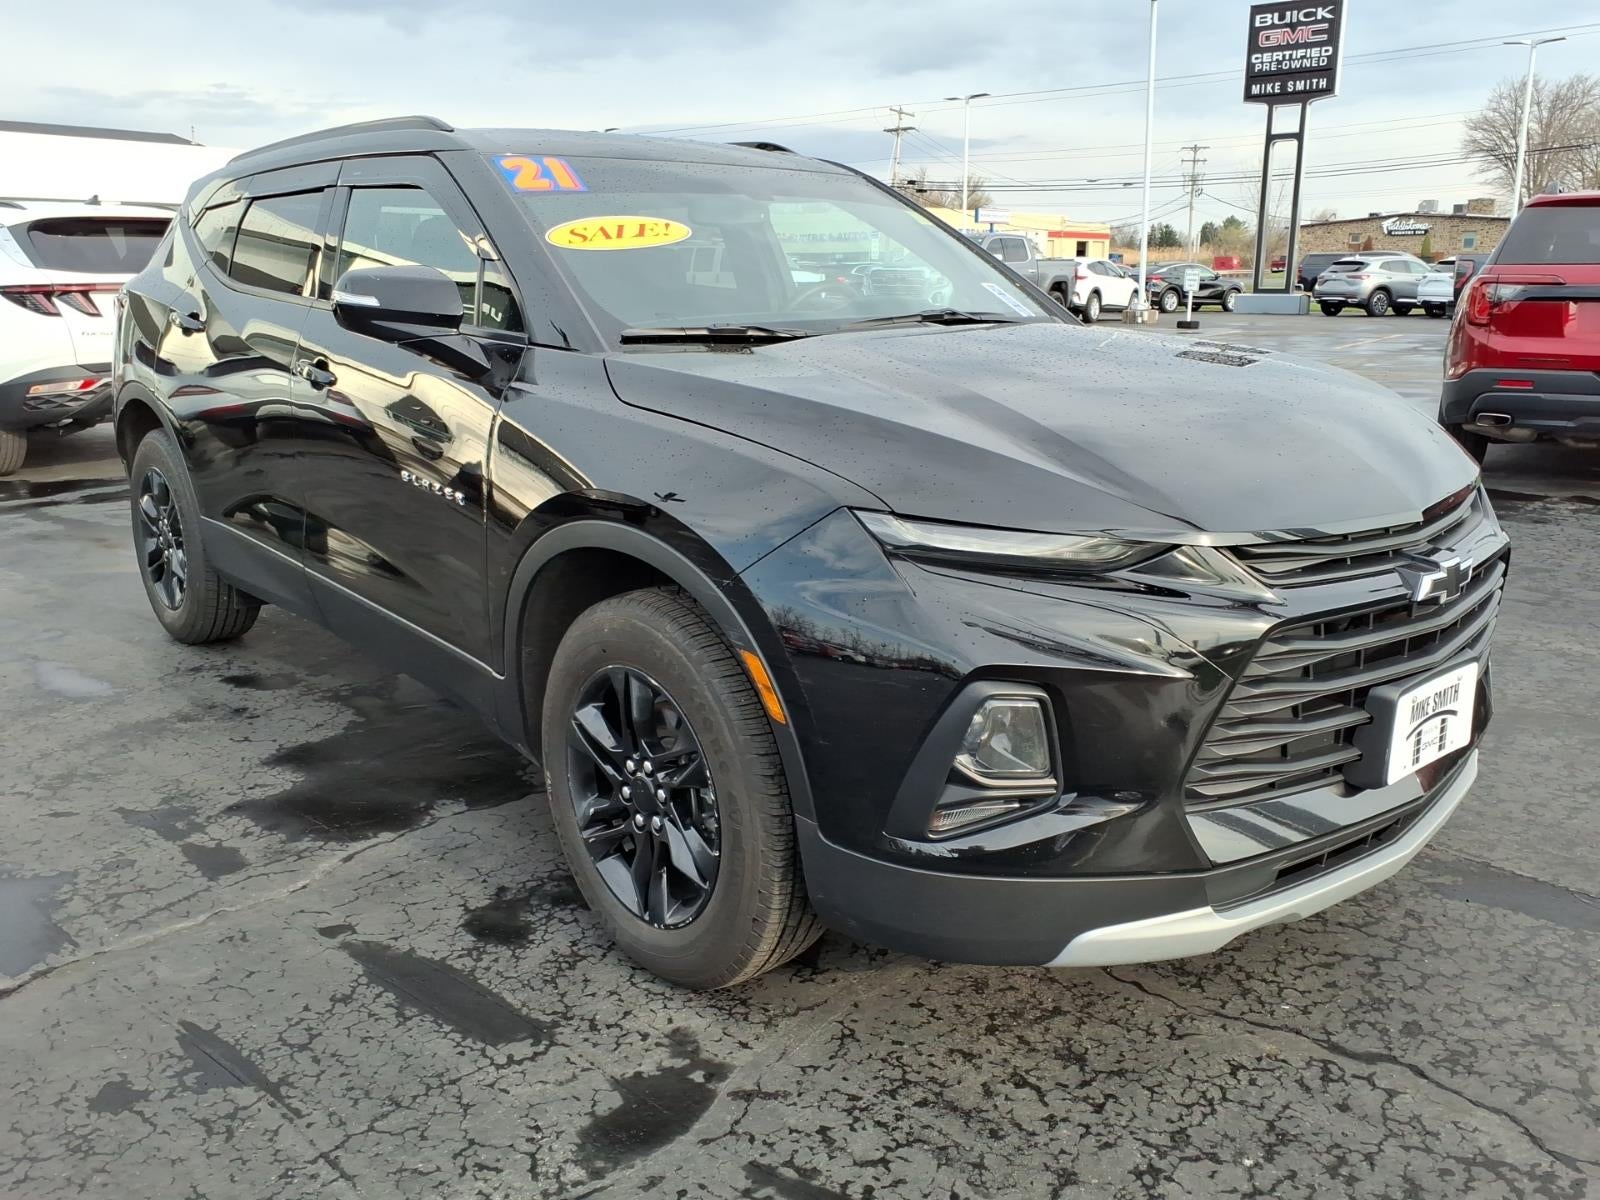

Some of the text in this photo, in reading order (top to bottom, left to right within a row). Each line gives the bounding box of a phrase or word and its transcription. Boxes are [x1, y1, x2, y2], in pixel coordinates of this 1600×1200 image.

[1255, 6, 1335, 27] BUICK
[1258, 23, 1329, 48] GMC
[1251, 46, 1333, 64] CERTIFIED
[1254, 56, 1328, 72] PRE-OWNED
[1251, 78, 1327, 95] MIKE SMITH
[500, 157, 583, 191] 21
[568, 222, 671, 244] SALE!
[401, 470, 466, 506] BLAZER
[1410, 682, 1460, 725] MIKE SMITH
